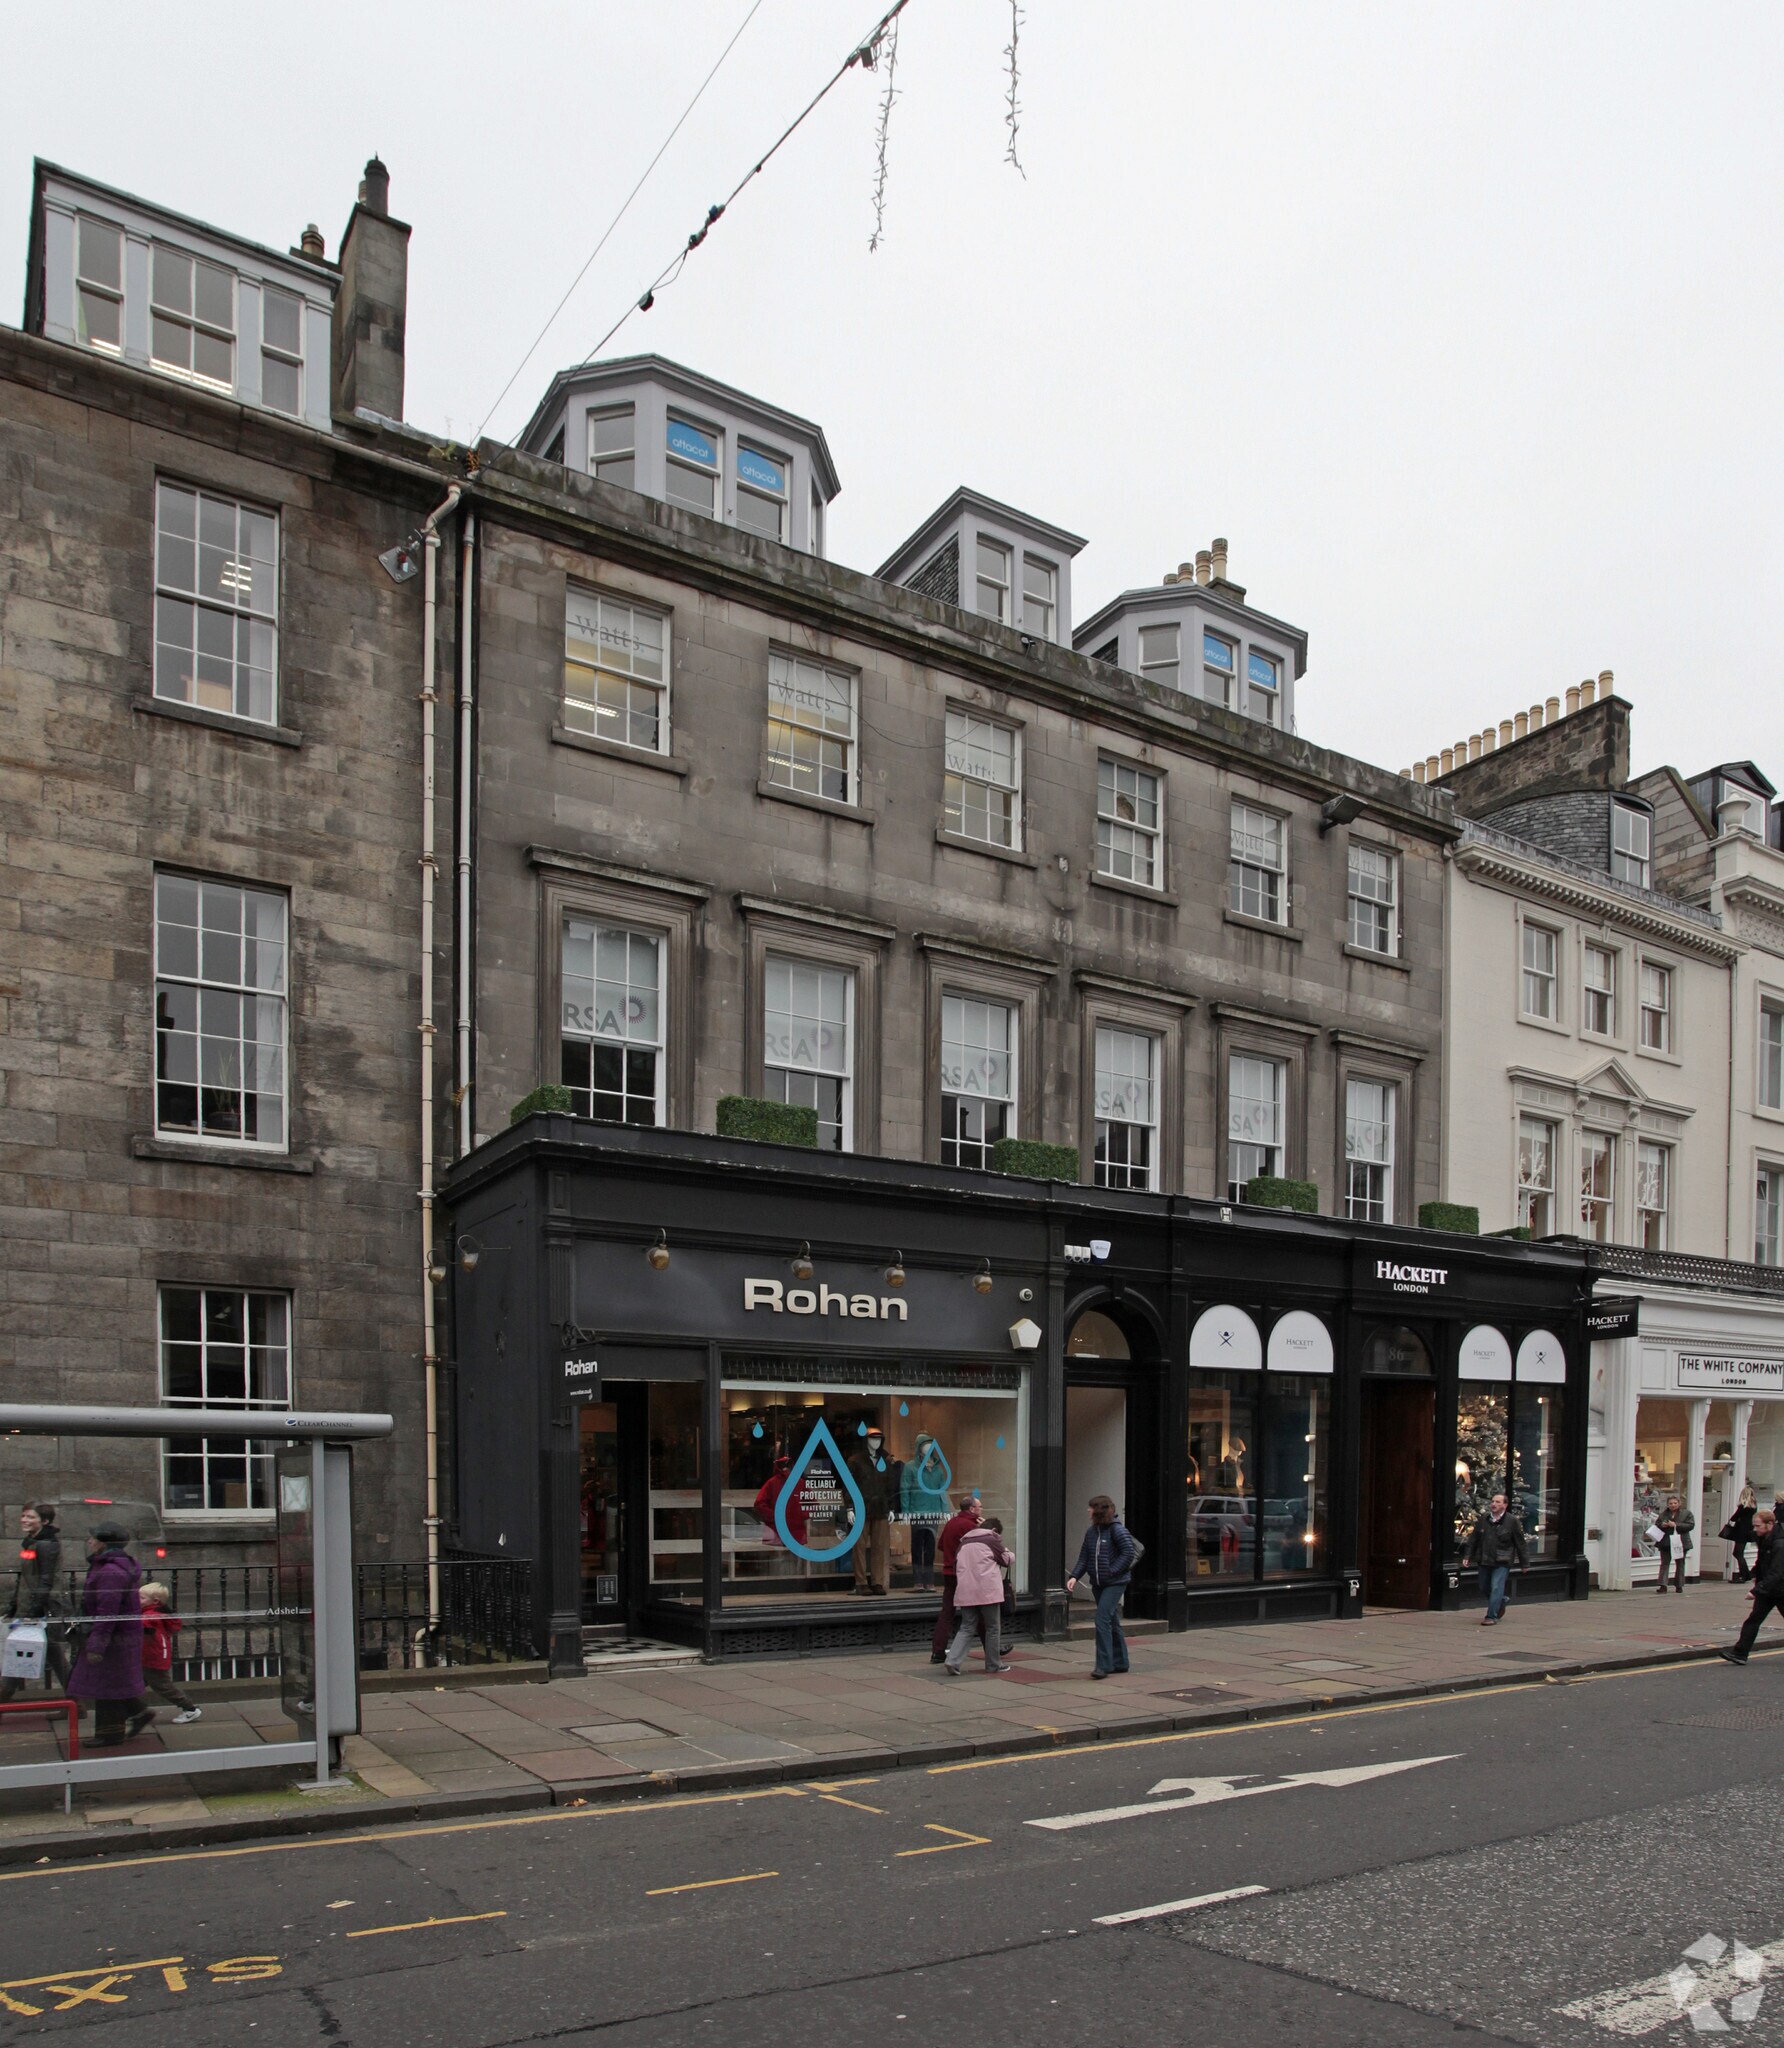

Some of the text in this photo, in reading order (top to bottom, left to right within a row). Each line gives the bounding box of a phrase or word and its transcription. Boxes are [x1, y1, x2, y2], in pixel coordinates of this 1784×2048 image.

[672, 438, 709, 457] attacat
[742, 465, 777, 484] attacat
[563, 1002, 622, 1036] RSA
[765, 1032, 813, 1063] RSA
[1377, 1260, 1448, 1285] HACKETT
[1393, 1282, 1429, 1294] LONDON
[744, 1277, 908, 1321] Rohan
[1587, 1314, 1630, 1326] HACKETT
[564, 1359, 598, 1377] Rohan
[1680, 1358, 1783, 1375] THE WHITE COMPANY
[805, 1480, 836, 1489] RELIABLY
[800, 1491, 842, 1500] PROTECTIVE
[267, 1606, 299, 1615] Adshel
